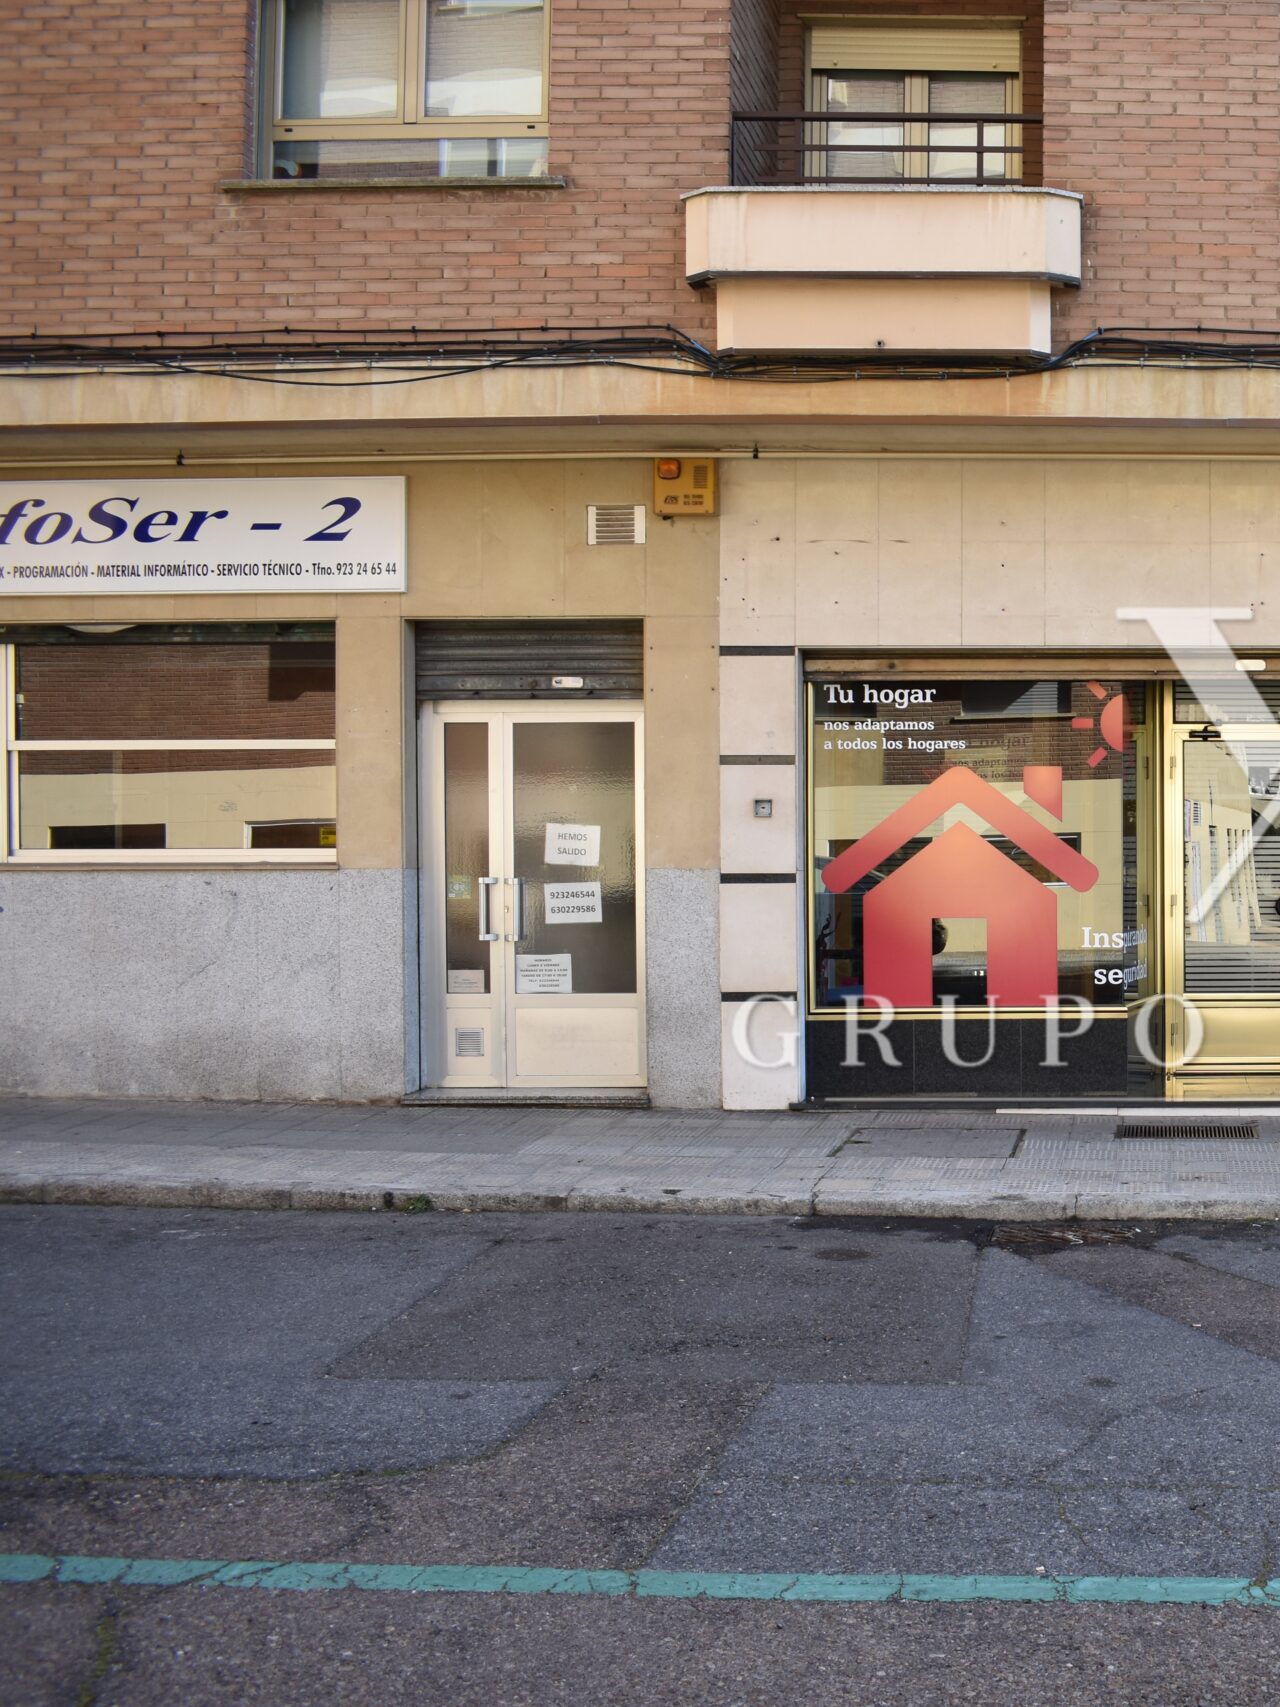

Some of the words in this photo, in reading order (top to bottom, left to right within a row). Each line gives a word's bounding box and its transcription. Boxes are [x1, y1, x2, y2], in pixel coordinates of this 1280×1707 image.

[303, 497, 362, 541] 2
[13, 562, 88, 578] PROGRAMACIÓN
[97, 564, 141, 577] MATERIAL
[144, 560, 209, 577] INFORMÁTICO
[217, 563, 259, 576] SERVICIO
[263, 560, 302, 576] TÉCNICO
[336, 563, 354, 576] 923
[357, 563, 368, 575] 24
[370, 563, 382, 575] 65
[385, 562, 397, 575] 44
[823, 684, 855, 704] Tu
[863, 684, 936, 708] hogar
[824, 721, 849, 731] nos
[854, 719, 935, 733] adaptamos
[824, 740, 832, 749] a
[837, 738, 877, 749] todos
[882, 738, 904, 749] los
[908, 738, 966, 752] hogares
[557, 833, 588, 841] HEMOS
[557, 847, 587, 856] SALIDO
[550, 890, 595, 899] 923246544
[550, 905, 596, 914] 630229586
